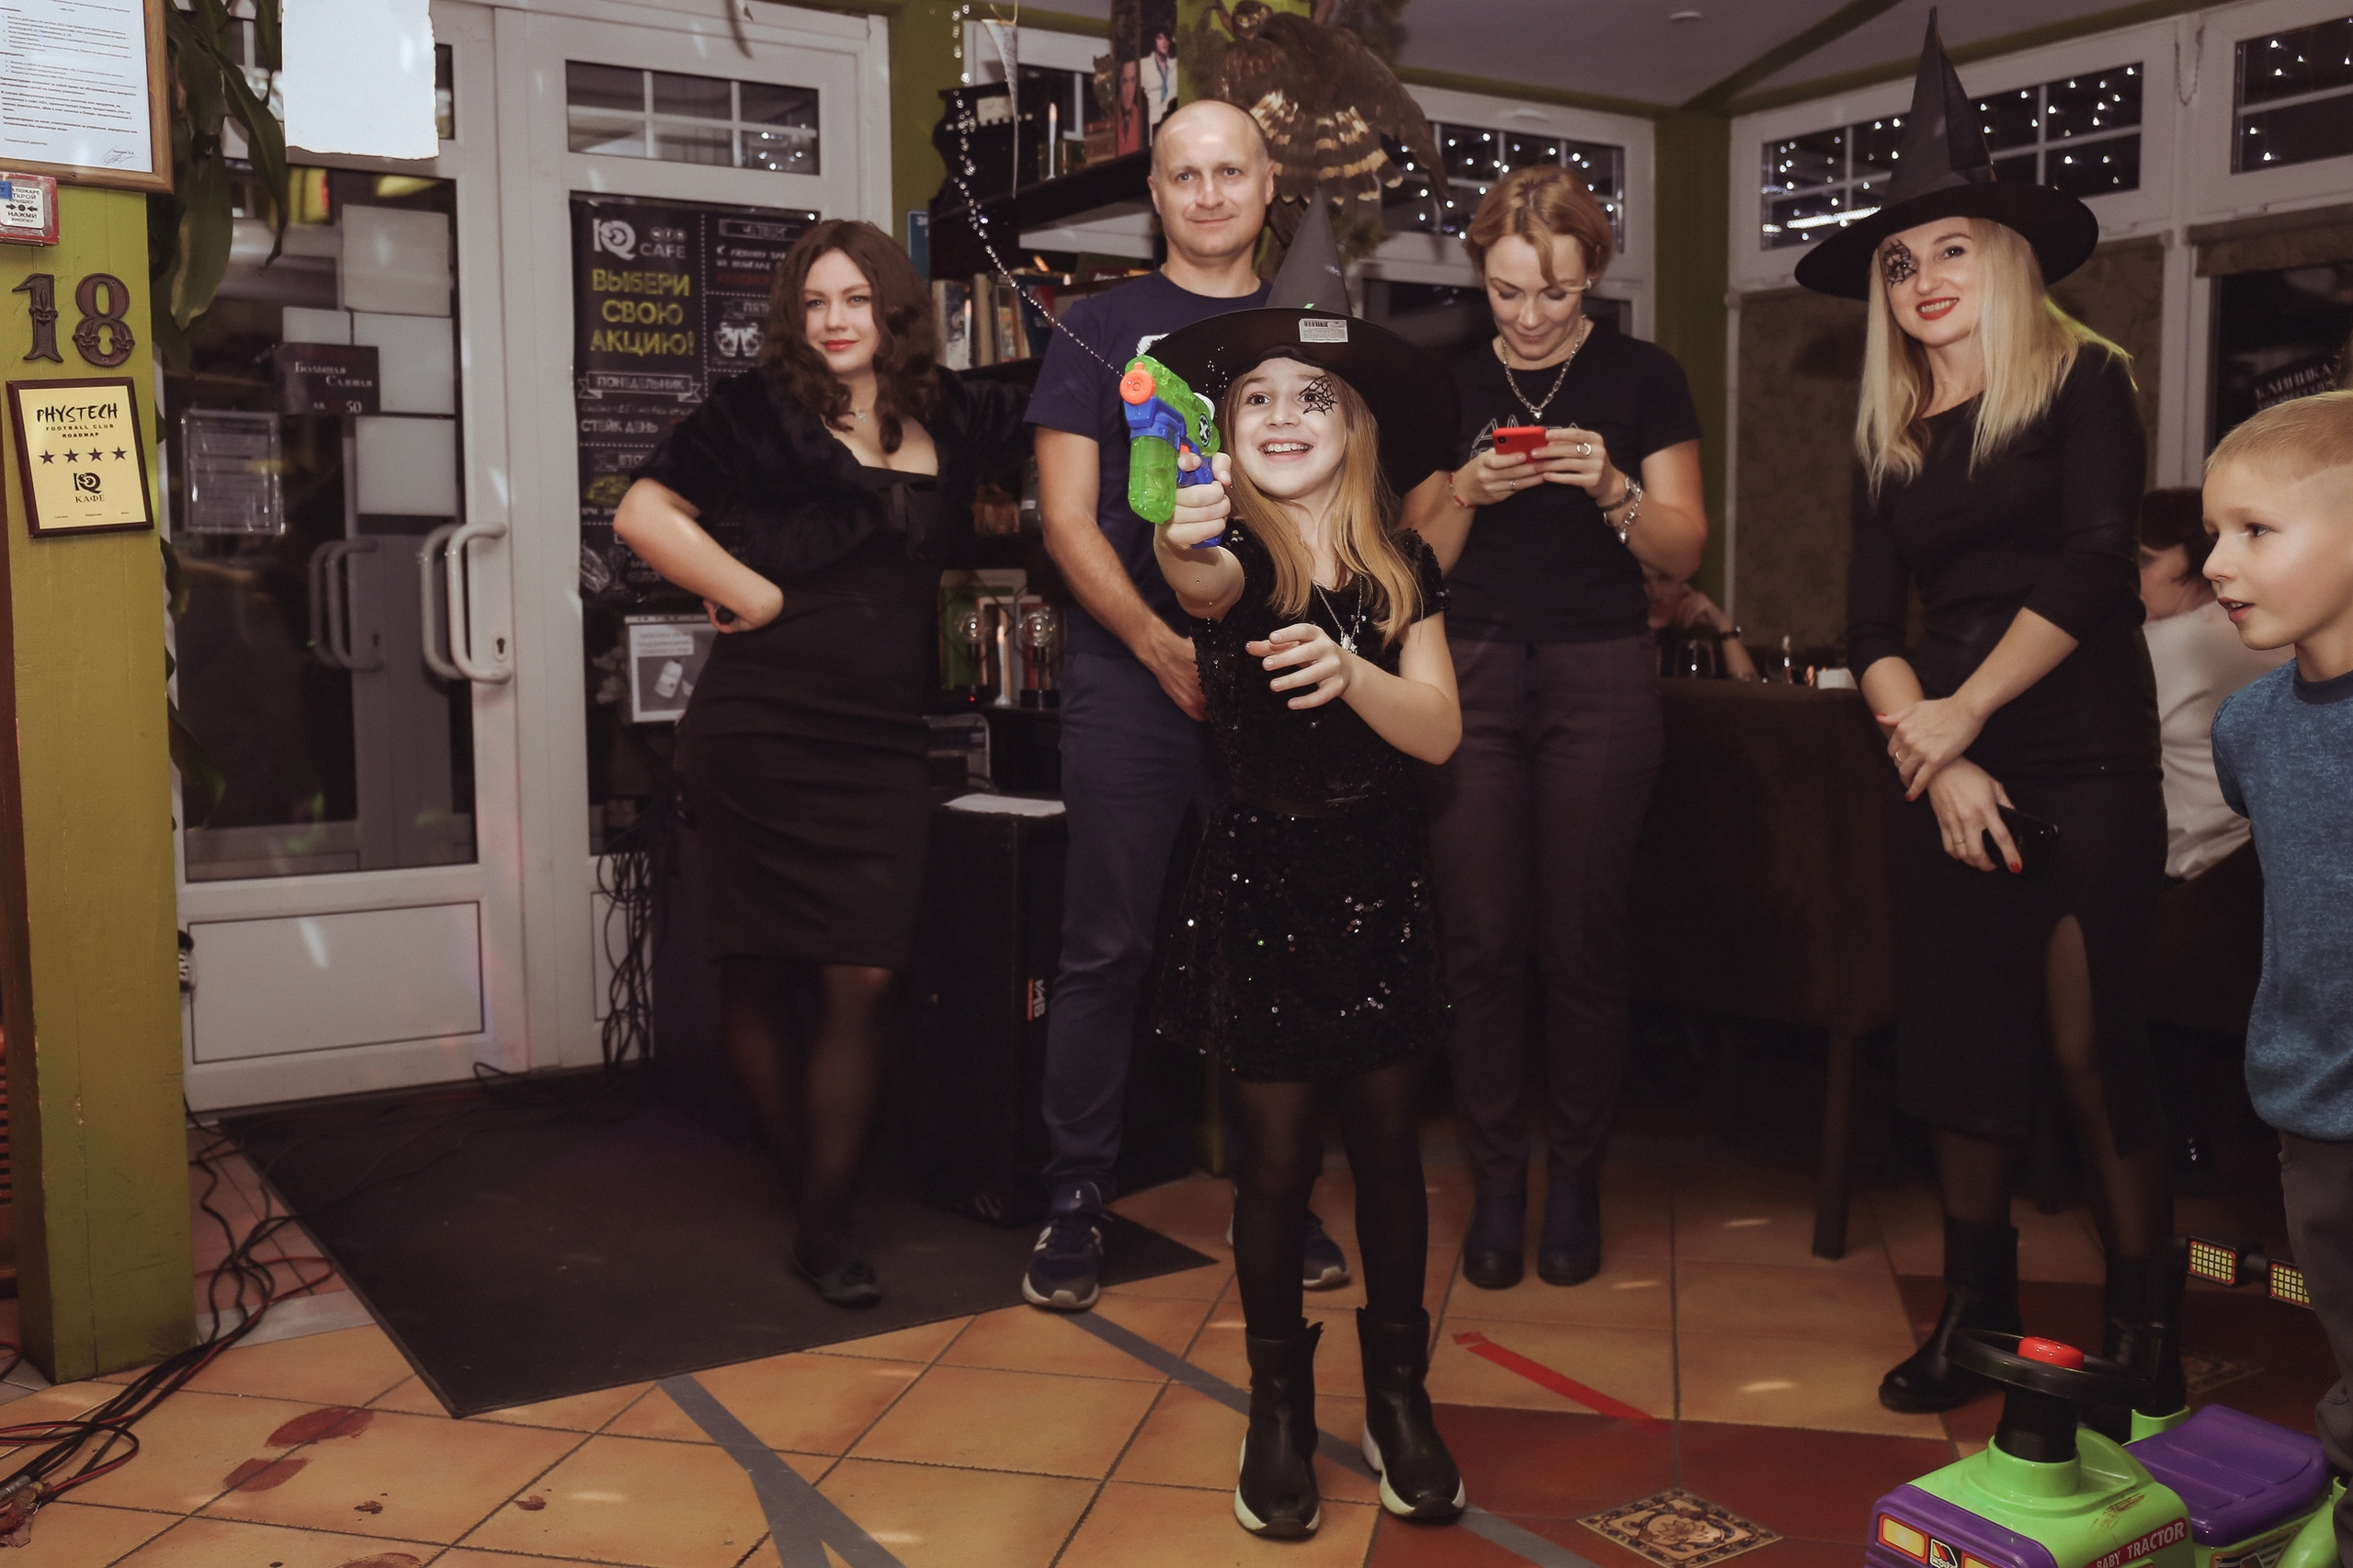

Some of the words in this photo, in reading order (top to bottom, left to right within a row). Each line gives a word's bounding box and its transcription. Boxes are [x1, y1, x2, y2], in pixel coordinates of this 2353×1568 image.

[639, 243, 687, 259] CAFE
[591, 267, 691, 297] ВЫБЕРИ
[12, 273, 136, 367] 18
[602, 299, 684, 326] СВОЮ
[589, 329, 696, 358] АКЦИЮ!
[37, 403, 119, 423] PHYSTECH
[346, 400, 363, 415] 50
[75, 494, 106, 504] КАФЕ
[2097, 1551, 2120, 1568] BABY
[2127, 1521, 2185, 1560] TRACTOR
